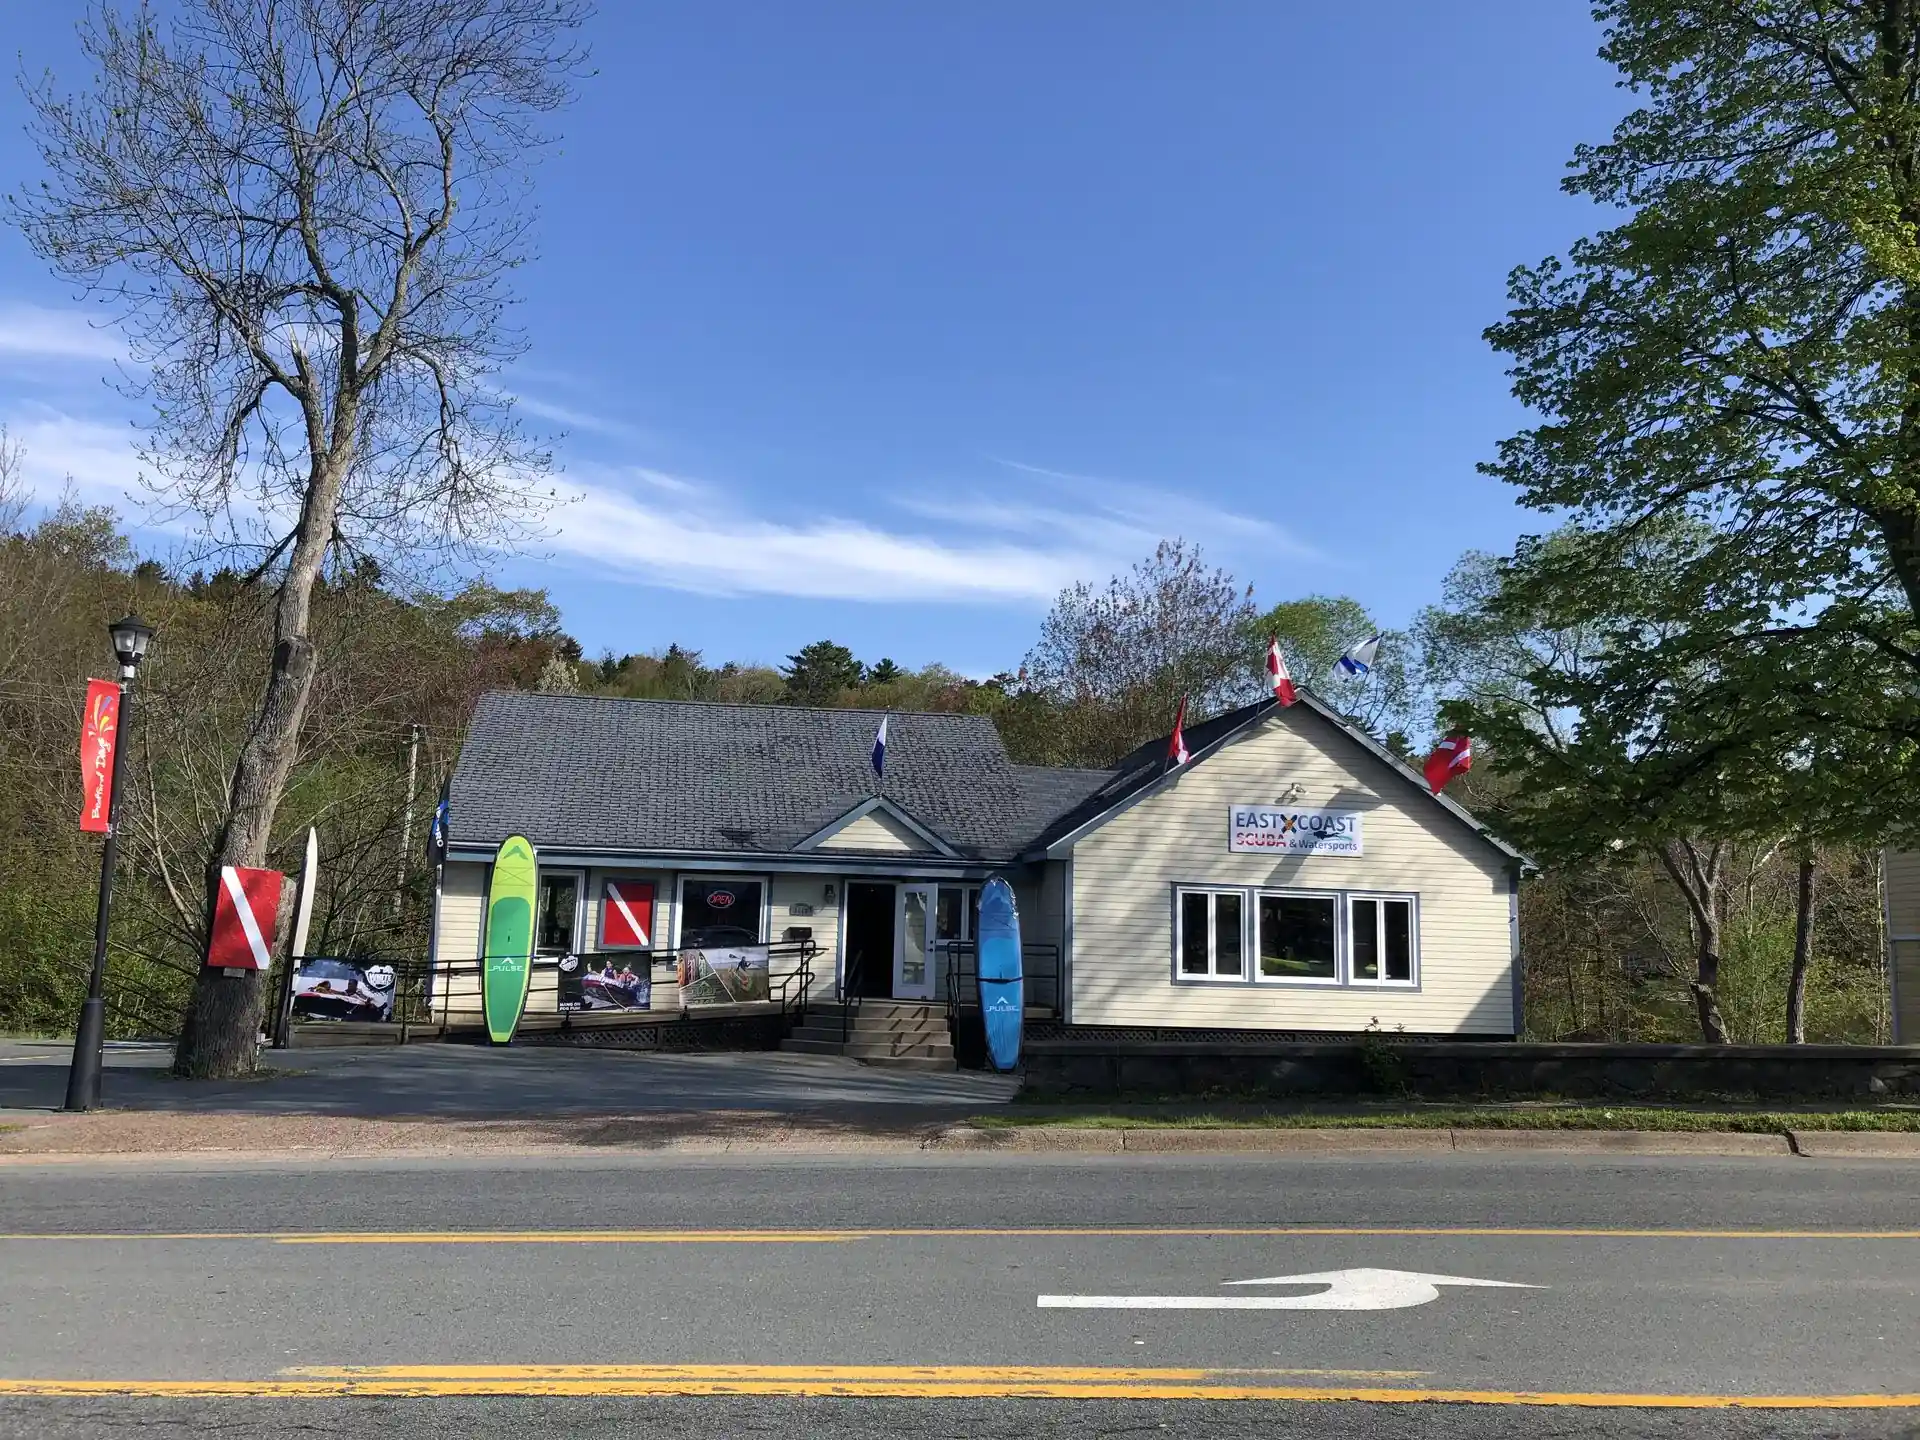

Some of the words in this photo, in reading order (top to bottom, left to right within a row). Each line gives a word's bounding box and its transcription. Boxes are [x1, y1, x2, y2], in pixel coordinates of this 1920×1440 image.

[95, 737, 112, 769] Days
[1235, 812, 1279, 829] EAST
[1298, 815, 1357, 832] COAST
[1236, 832, 1287, 848] SCUBA
[1289, 839, 1298, 849] &
[1298, 838, 1358, 852] Watersports
[708, 894, 733, 905] OPEN
